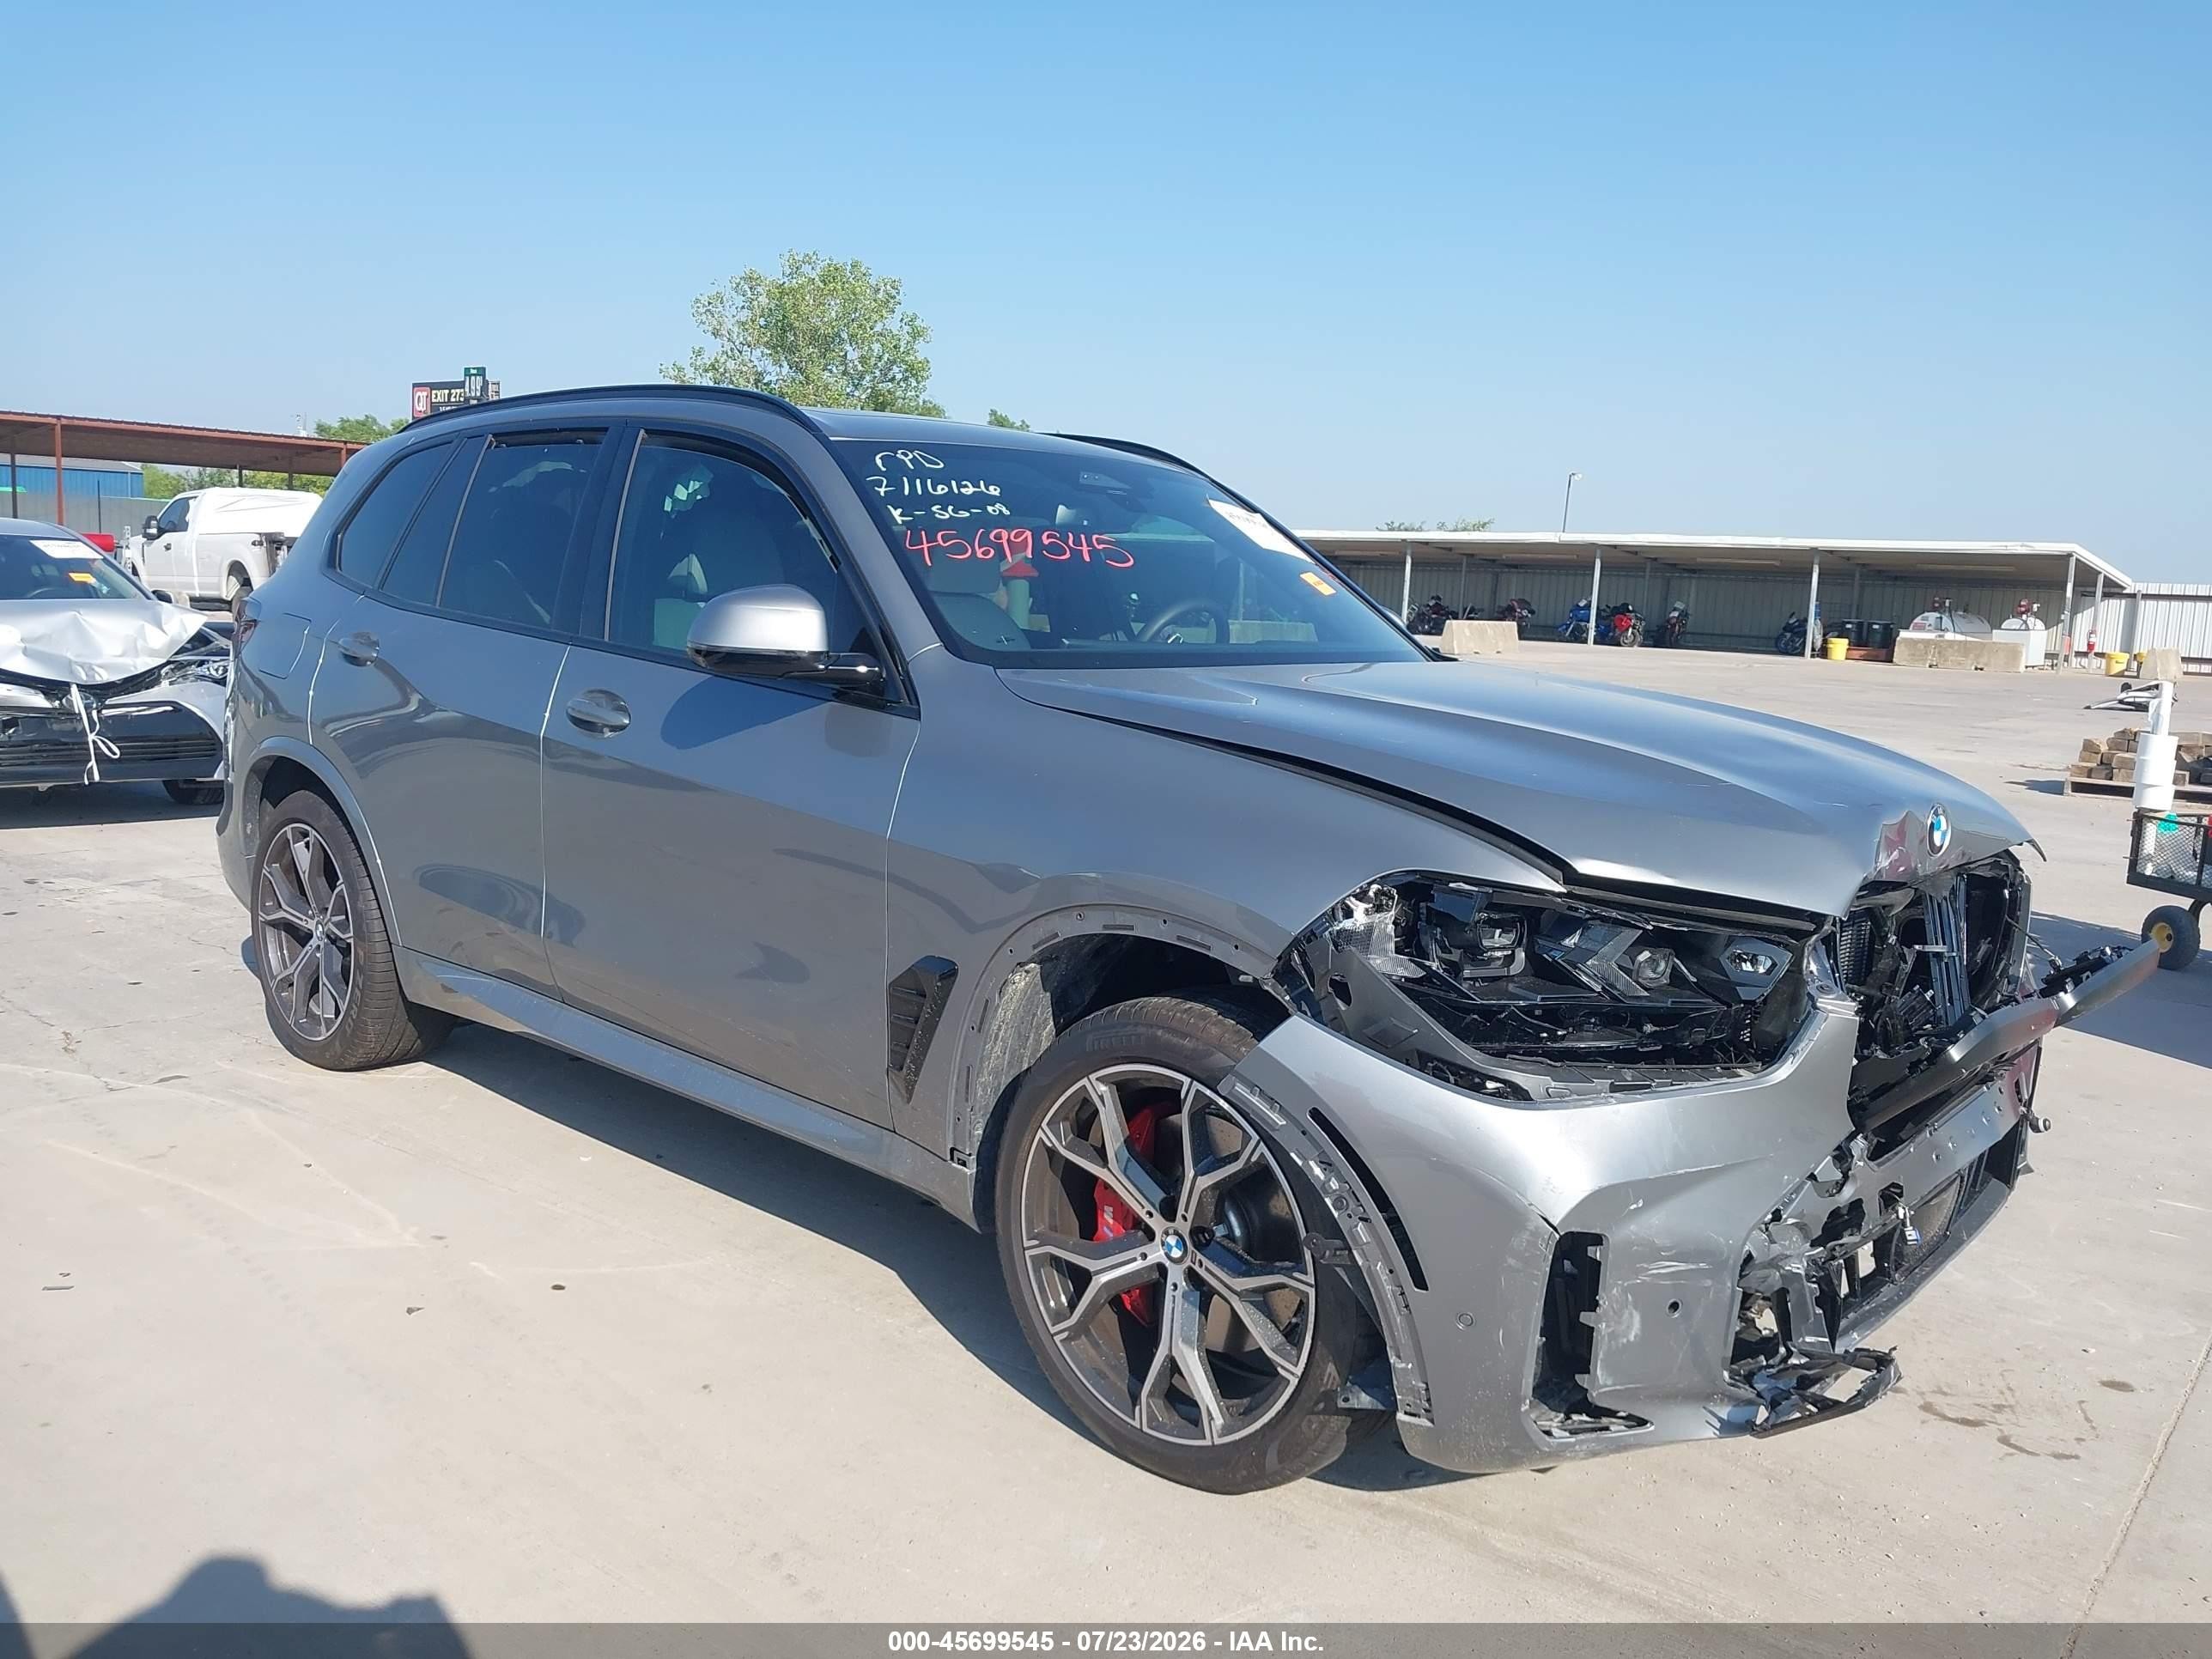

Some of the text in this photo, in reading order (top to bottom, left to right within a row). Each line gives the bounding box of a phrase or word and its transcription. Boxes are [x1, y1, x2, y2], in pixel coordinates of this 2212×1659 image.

[415, 392, 428, 412] QT
[432, 390, 449, 402] EXIT
[904, 527, 1135, 568] 45699545
